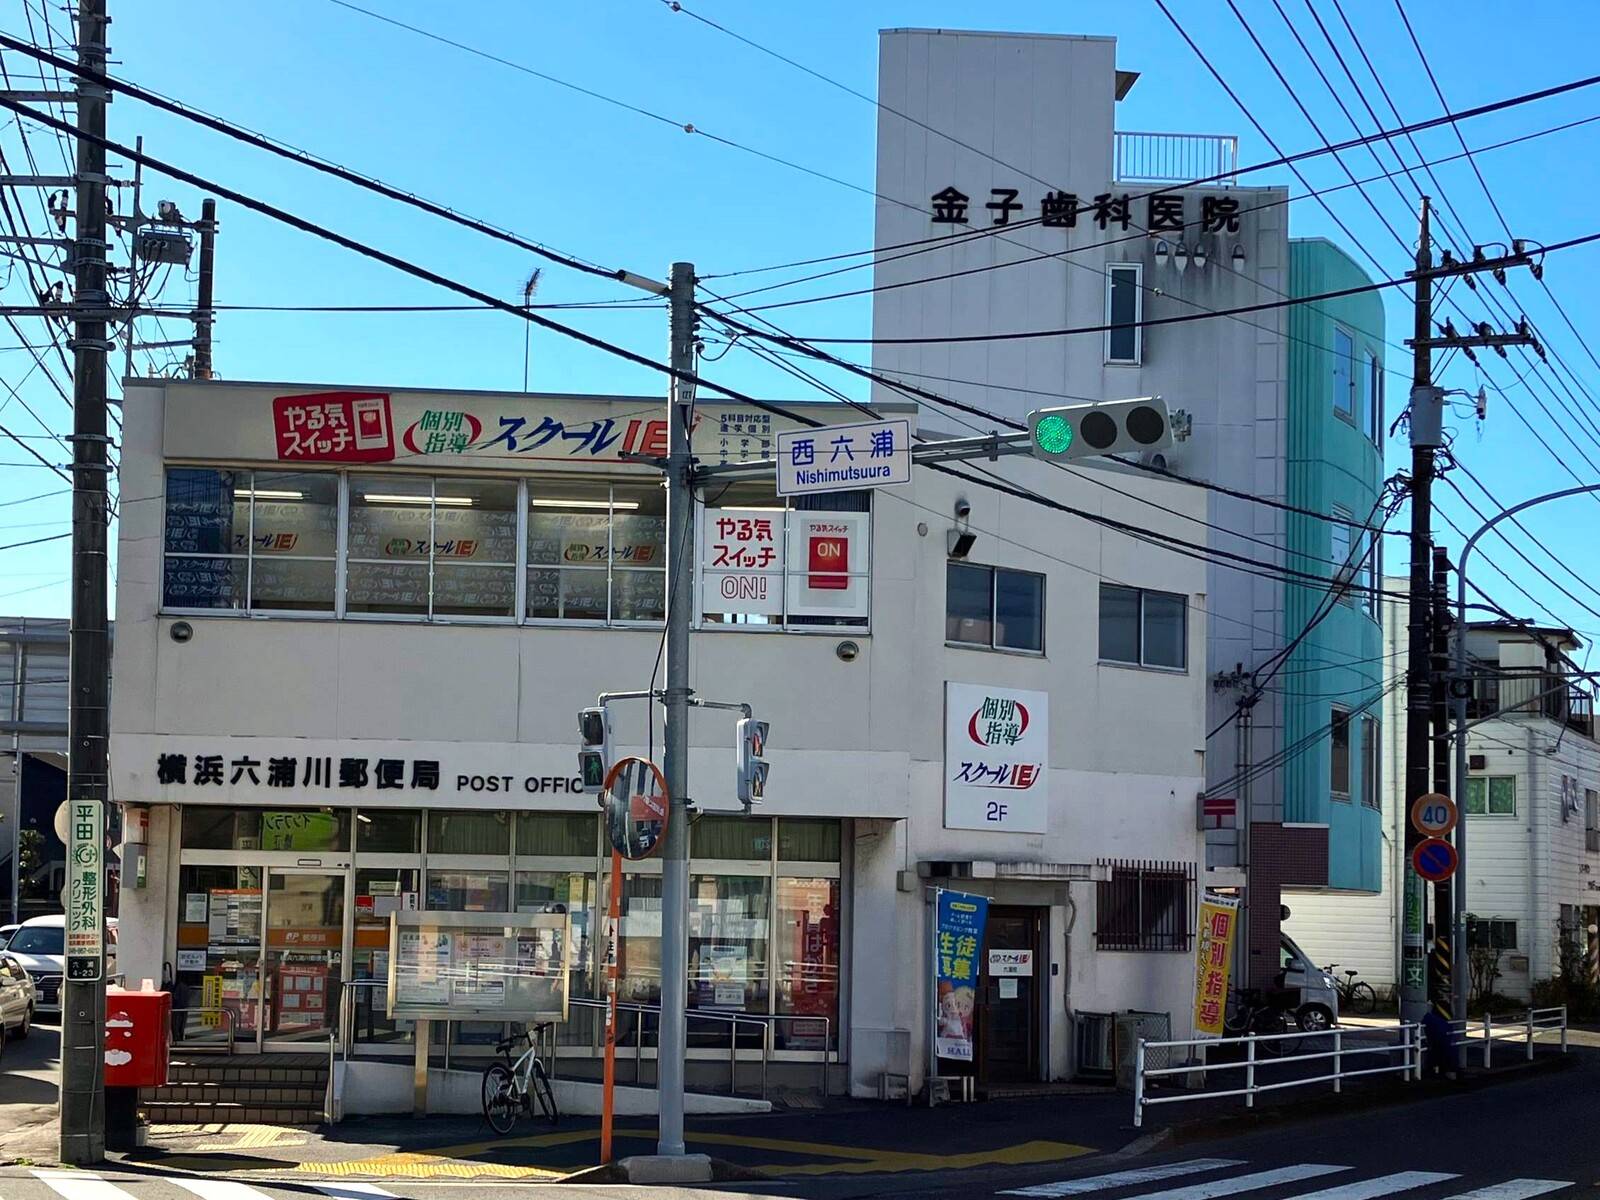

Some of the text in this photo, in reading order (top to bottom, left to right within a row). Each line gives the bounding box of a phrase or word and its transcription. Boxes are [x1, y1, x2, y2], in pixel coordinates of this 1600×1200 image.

[931, 186, 1240, 233] 金子歯科医院
[284, 402, 349, 431] やる気
[420, 410, 465, 432] 個別
[283, 429, 353, 457] スイッチ
[424, 431, 471, 455] 指導
[791, 431, 894, 466] 西六浦
[795, 464, 892, 487] Nishimutsuura
[715, 516, 774, 542] やる気
[809, 523, 849, 534] やる気スイッチ
[712, 544, 776, 568] スイッチ
[817, 542, 840, 557] ON
[721, 576, 766, 600] ON!
[981, 696, 1016, 722] 個別
[985, 721, 1022, 746] 指導
[157, 753, 441, 790] 横浜六浦川郵便局
[952, 761, 1036, 786] スクールIE
[456, 775, 583, 794] POST OFFIC
[76, 804, 94, 840] 平田
[986, 801, 1008, 822] 2F
[1422, 805, 1448, 826] 40
[71, 879, 81, 931] クリニック
[81, 871, 97, 931] 整形外科
[939, 932, 977, 957] 生徒
[72, 969, 94, 977] 4-23
[1200, 911, 1231, 1026] 個別指導
